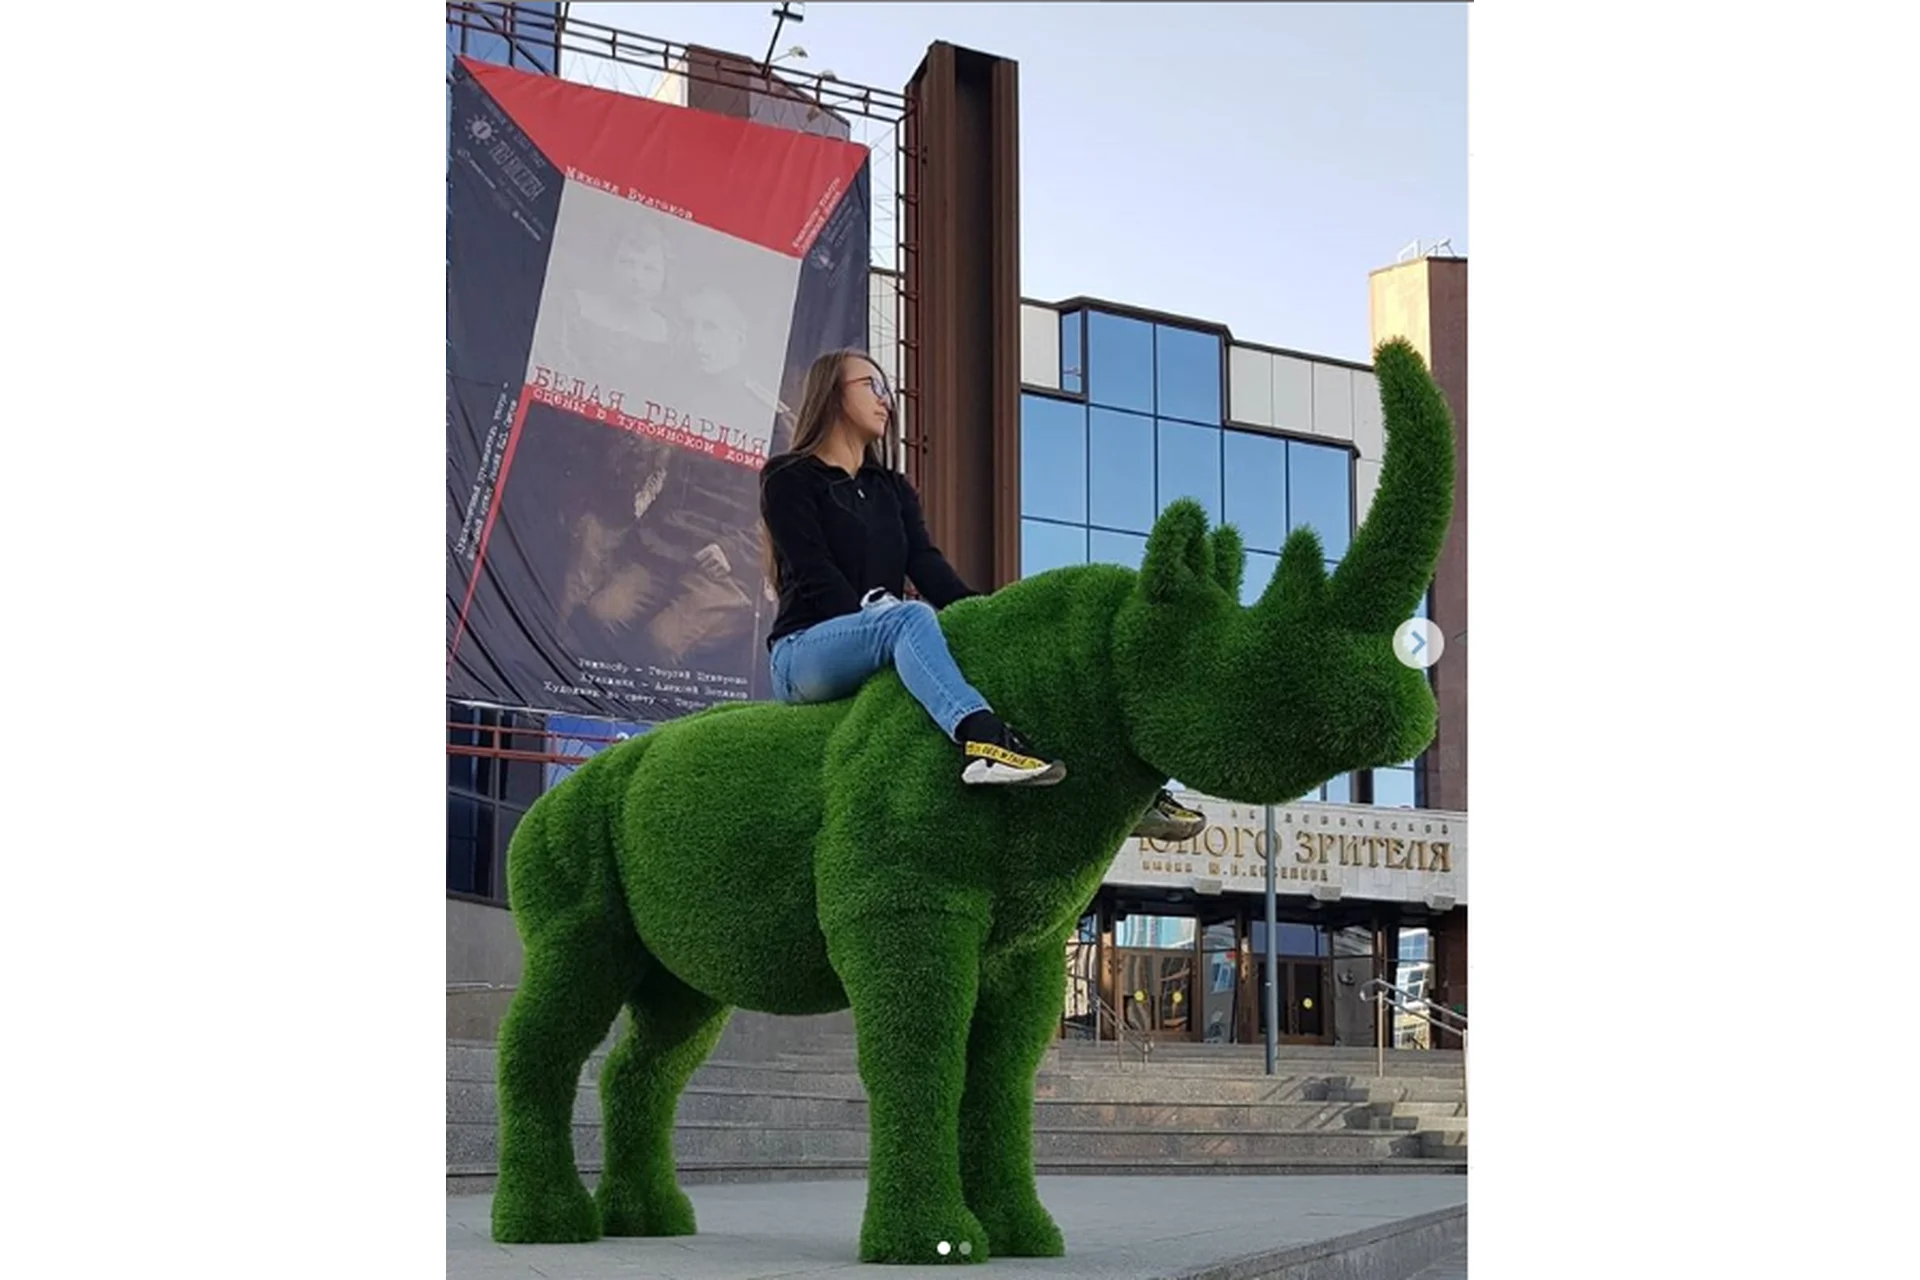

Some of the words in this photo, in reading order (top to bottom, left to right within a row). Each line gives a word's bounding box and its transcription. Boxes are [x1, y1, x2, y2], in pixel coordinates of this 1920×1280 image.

[626, 187, 694, 221] Булгаков
[533, 387, 587, 415] сцены
[617, 415, 716, 455] турбинском
[534, 366, 626, 413] БЕЛАЯ
[644, 400, 768, 457] ГВАРДИЯ
[1230, 807, 1449, 835] АКДЕМИЧЕСКИЙ
[1294, 830, 1453, 872] ЗРИТЕЛЯ
